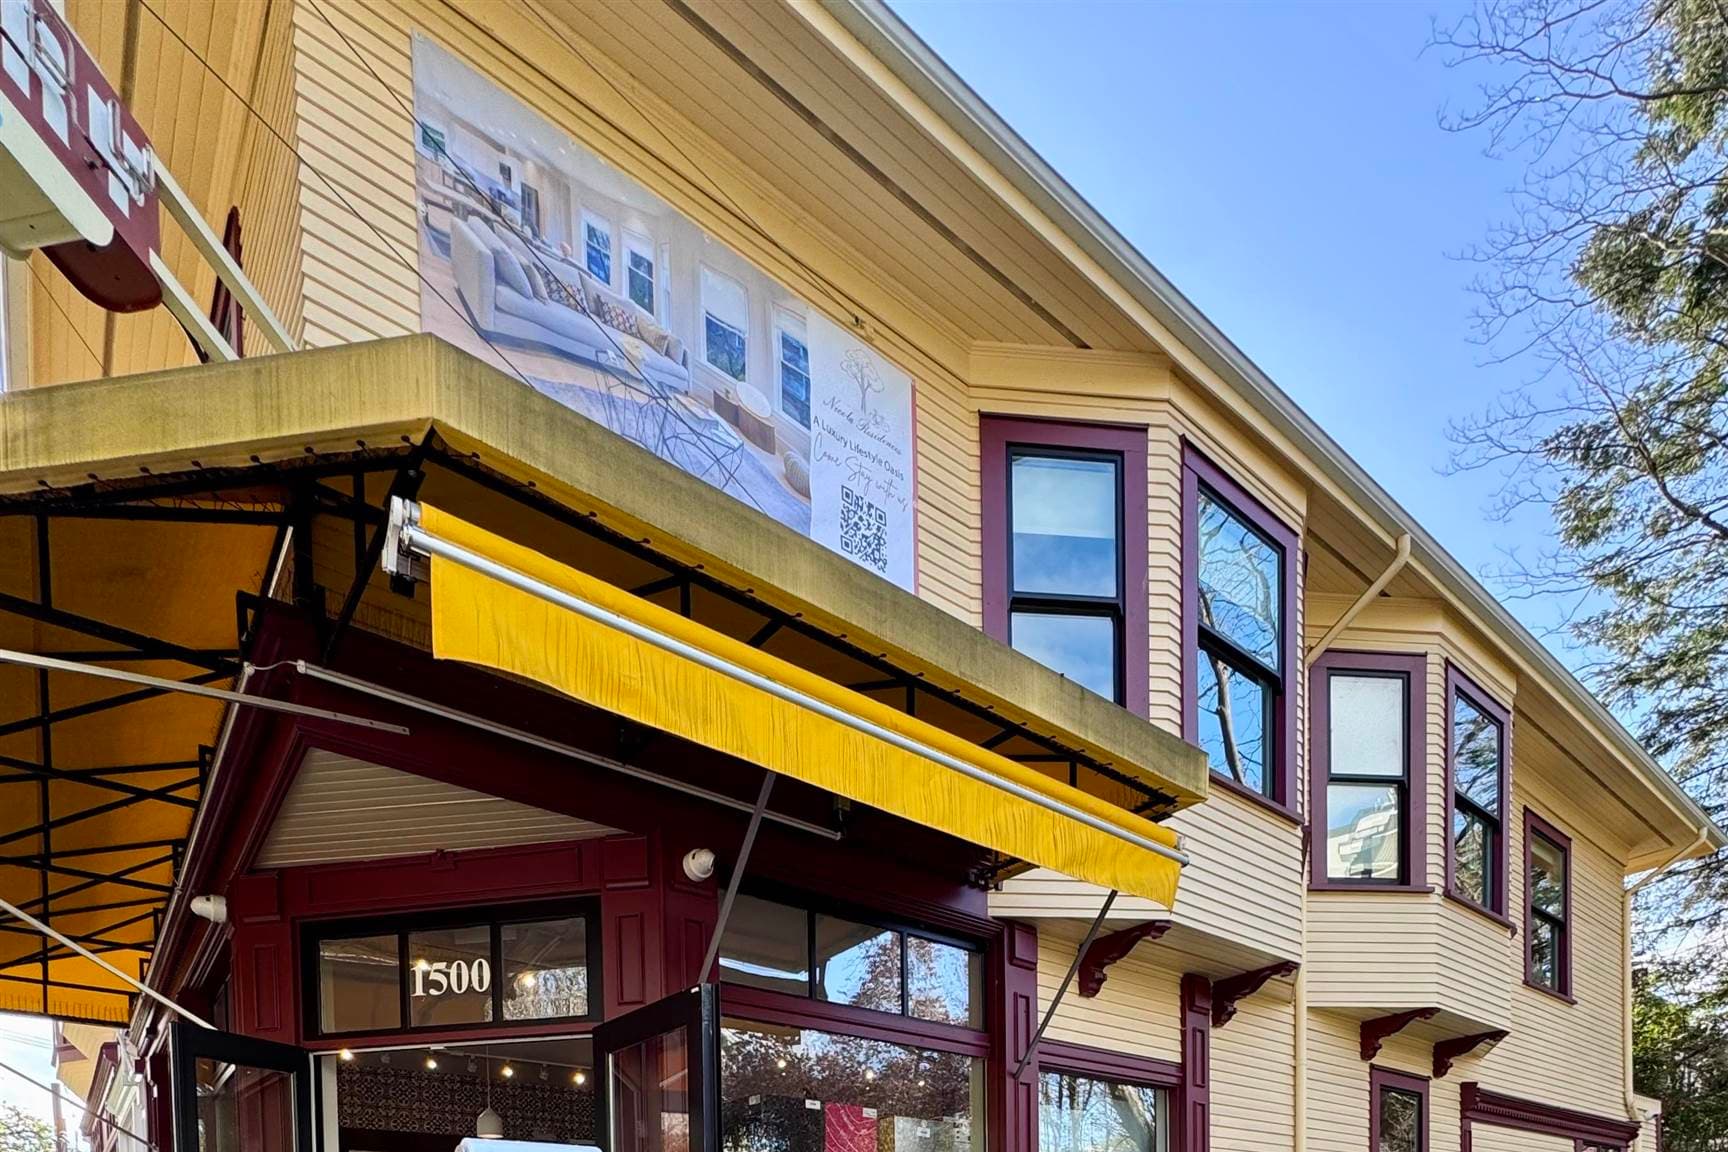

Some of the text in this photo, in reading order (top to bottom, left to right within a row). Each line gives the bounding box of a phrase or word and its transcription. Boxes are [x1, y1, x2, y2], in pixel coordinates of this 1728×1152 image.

[813, 415, 904, 481] A Luxury Lifestyle Oasis
[814, 432, 842, 466] Come
[845, 456, 872, 497] Stay
[410, 958, 491, 997] 1500
